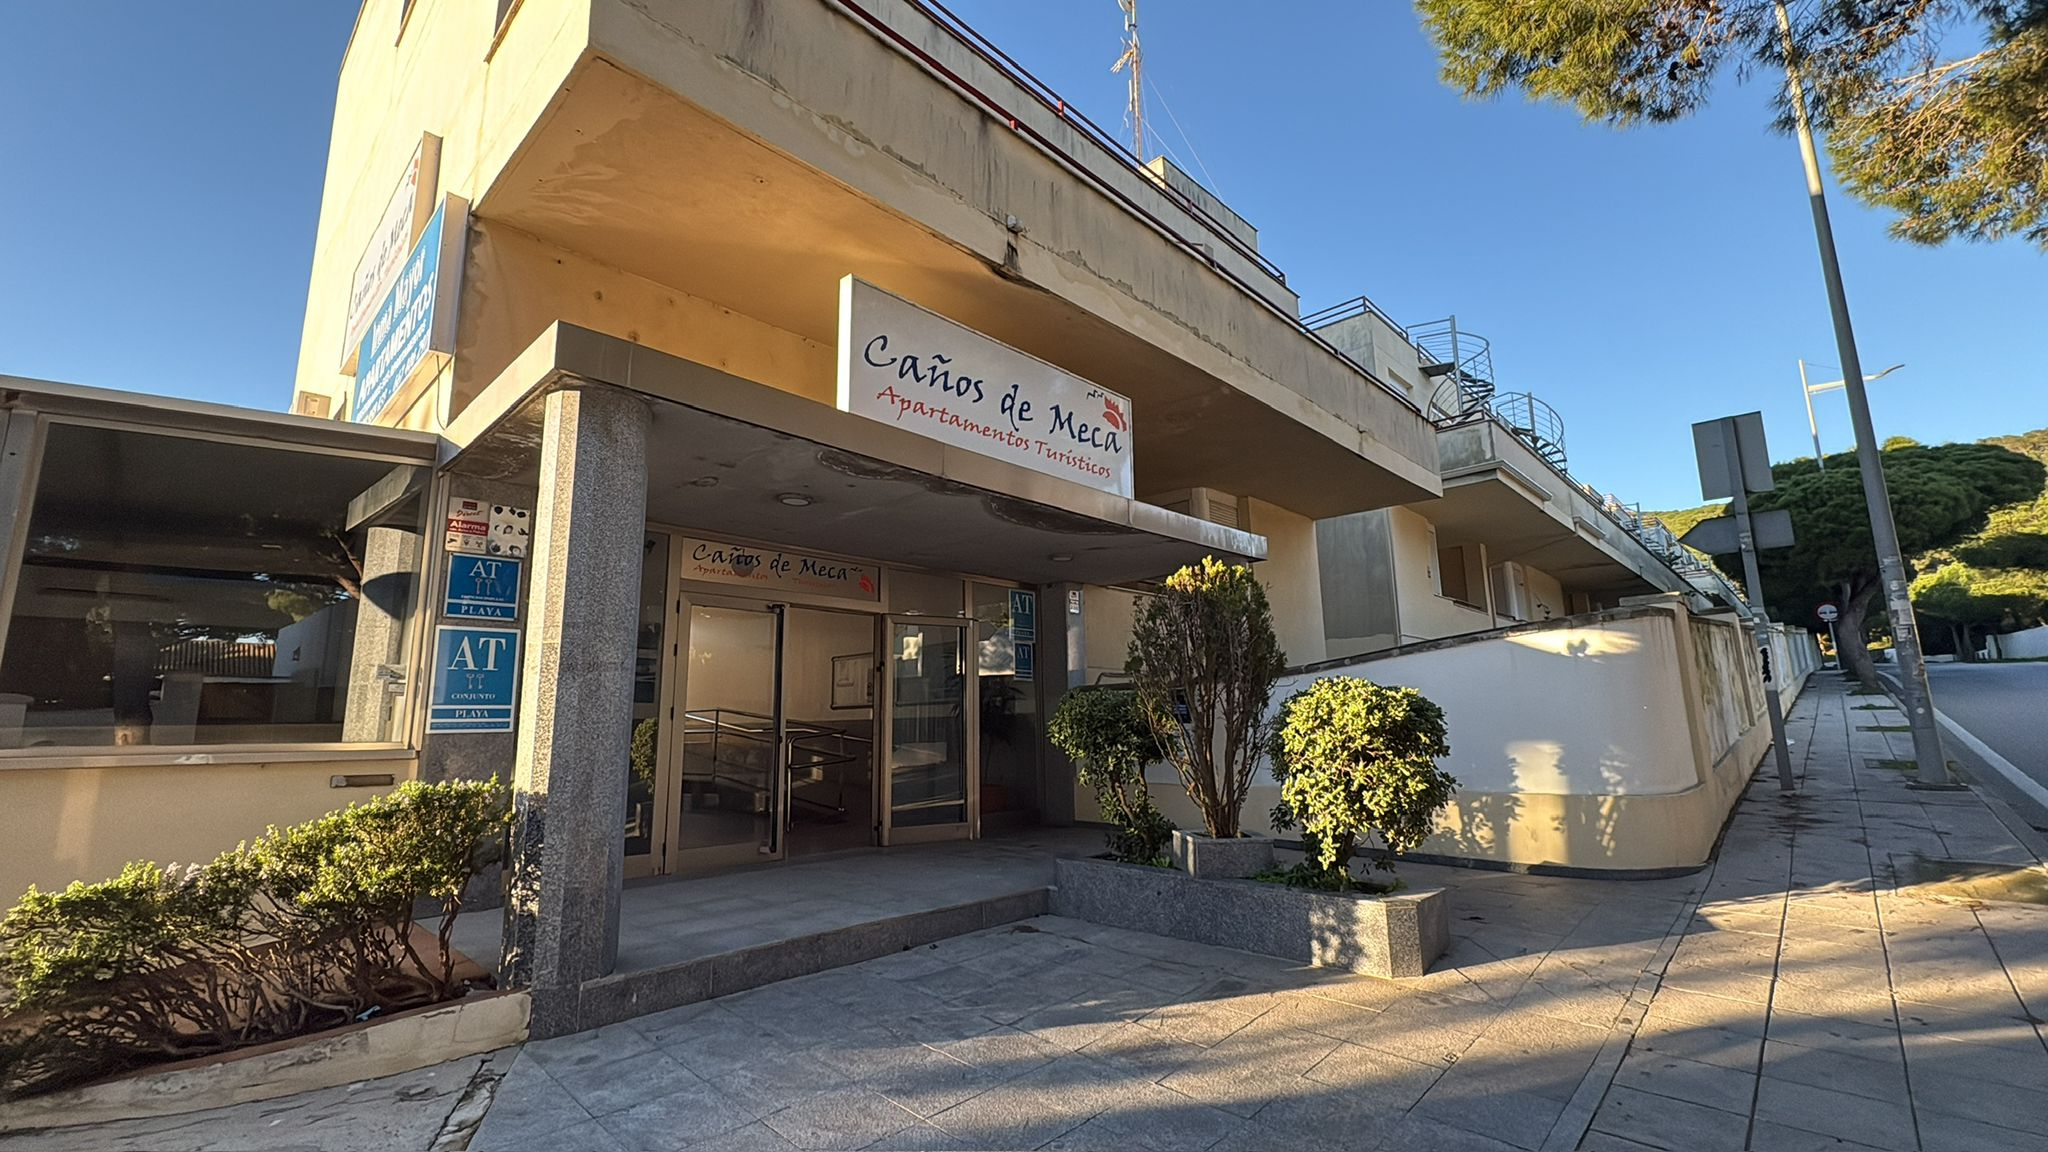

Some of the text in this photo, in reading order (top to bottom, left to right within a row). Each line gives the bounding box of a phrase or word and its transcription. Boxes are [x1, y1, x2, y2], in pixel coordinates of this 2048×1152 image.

[864, 334, 1123, 454] Caños de Meca
[876, 385, 1112, 479] Apartamentos Turísticos
[449, 520, 487, 531] Alarma
[468, 560, 502, 579] AT
[769, 553, 791, 578] de
[799, 558, 848, 580] Meca
[460, 605, 502, 616] PLAYA
[1012, 593, 1033, 615] AT
[447, 635, 506, 671] AT
[451, 692, 496, 701] CONJUNTO
[455, 709, 489, 718] PLAYA
